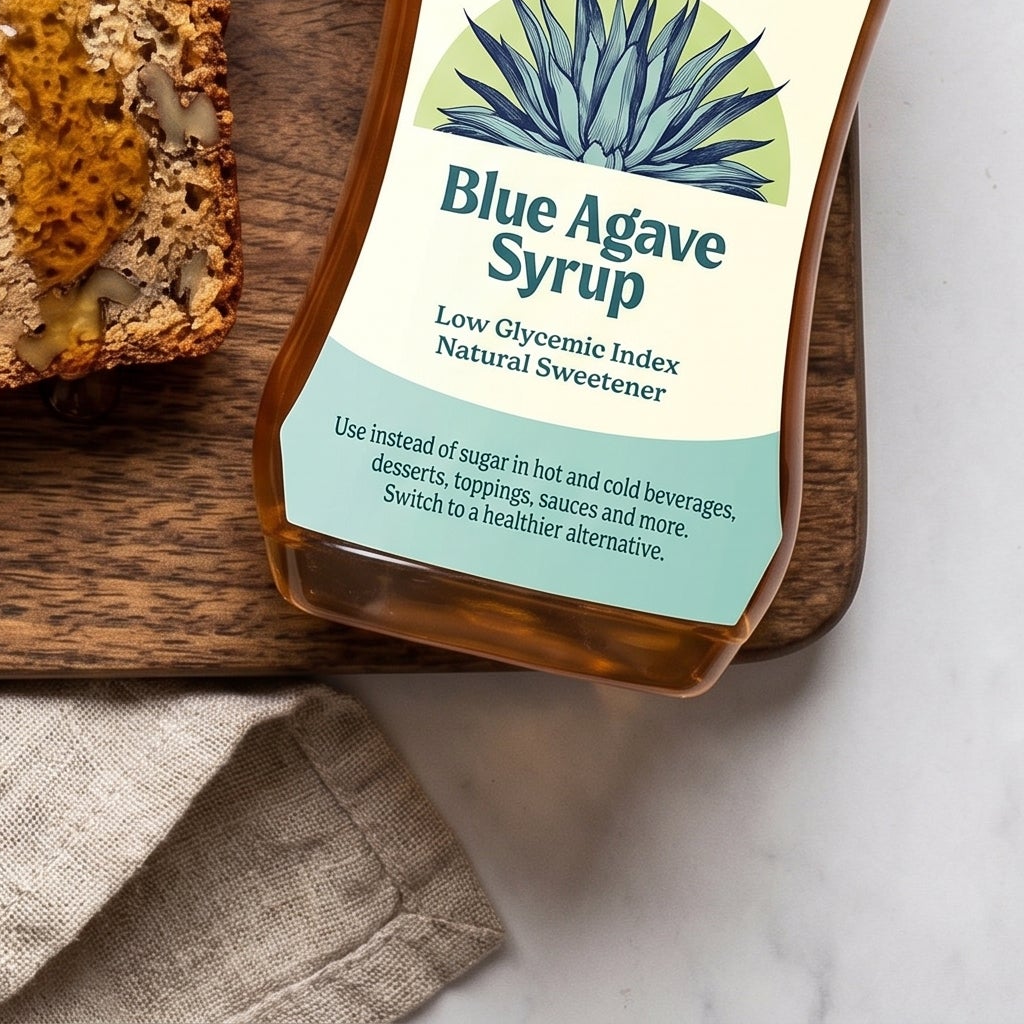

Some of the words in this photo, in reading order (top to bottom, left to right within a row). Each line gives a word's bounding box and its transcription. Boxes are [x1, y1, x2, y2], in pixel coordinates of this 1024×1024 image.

[440, 164, 557, 233] Blue
[565, 194, 726, 268] Agave
[488, 232, 645, 319] Syrup
[435, 305, 490, 333] Low
[495, 319, 605, 358] Glycemic
[610, 343, 680, 375] Index
[435, 335, 530, 373] Natural
[536, 358, 666, 402] Sweetener
[335, 416, 367, 440] Use
[370, 424, 435, 455] instead
[438, 441, 459, 459] of
[459, 448, 510, 472] sugar
[513, 454, 529, 476] in
[533, 458, 563, 483] hot
[566, 471, 600, 491] and
[604, 477, 641, 499] cold
[644, 482, 736, 523] beverages,
[371, 453, 449, 489] desserts,
[454, 473, 533, 507] toppings,
[539, 493, 598, 518] sauces
[601, 506, 636, 526] and
[639, 515, 688, 538] more.
[384, 484, 444, 514] Switch
[448, 498, 465, 519] to
[469, 506, 478, 521] a
[482, 505, 563, 538] healthier
[566, 523, 664, 561] alternative.
